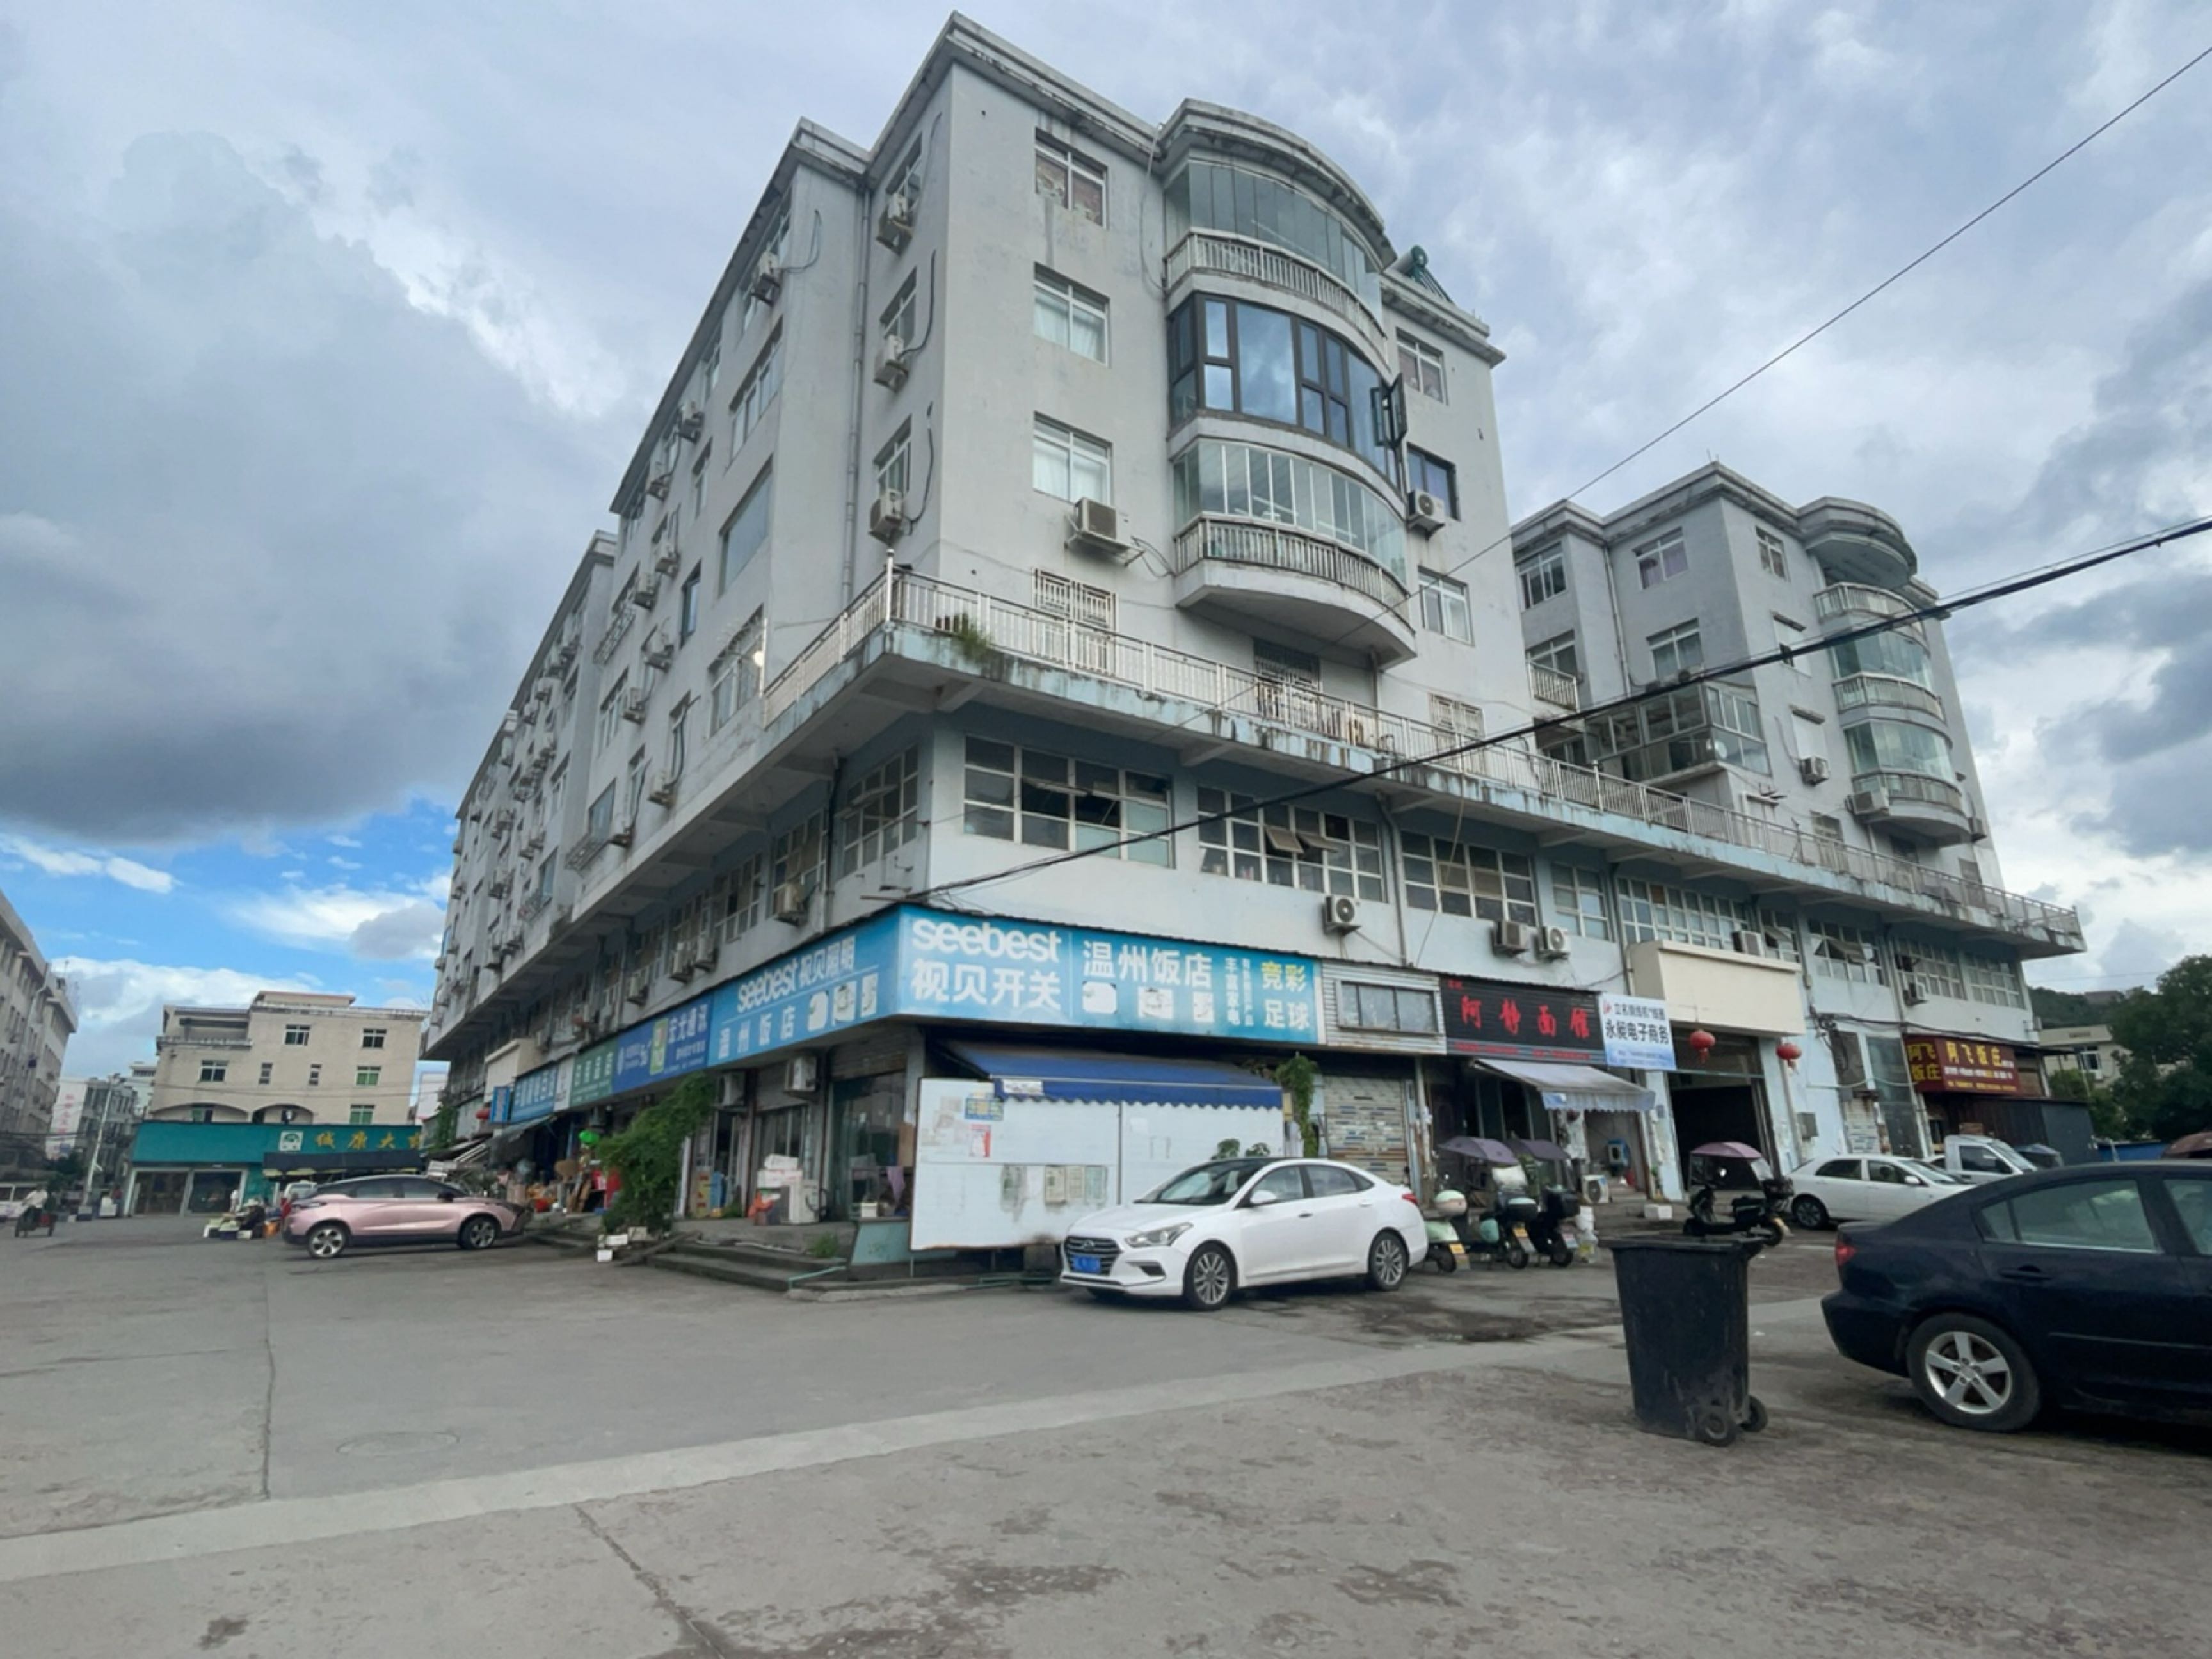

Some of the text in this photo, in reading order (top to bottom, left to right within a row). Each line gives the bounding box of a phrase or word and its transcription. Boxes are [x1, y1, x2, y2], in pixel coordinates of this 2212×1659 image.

[911, 918, 1062, 964] seebest
[1082, 940, 1214, 990] 温州饭店
[737, 956, 799, 1014] seebest
[912, 958, 1062, 1012] 视贝开关
[1261, 961, 1306, 992] 竞彩
[718, 1003, 796, 1060] 温州饭店
[1264, 999, 1310, 1030] 足球
